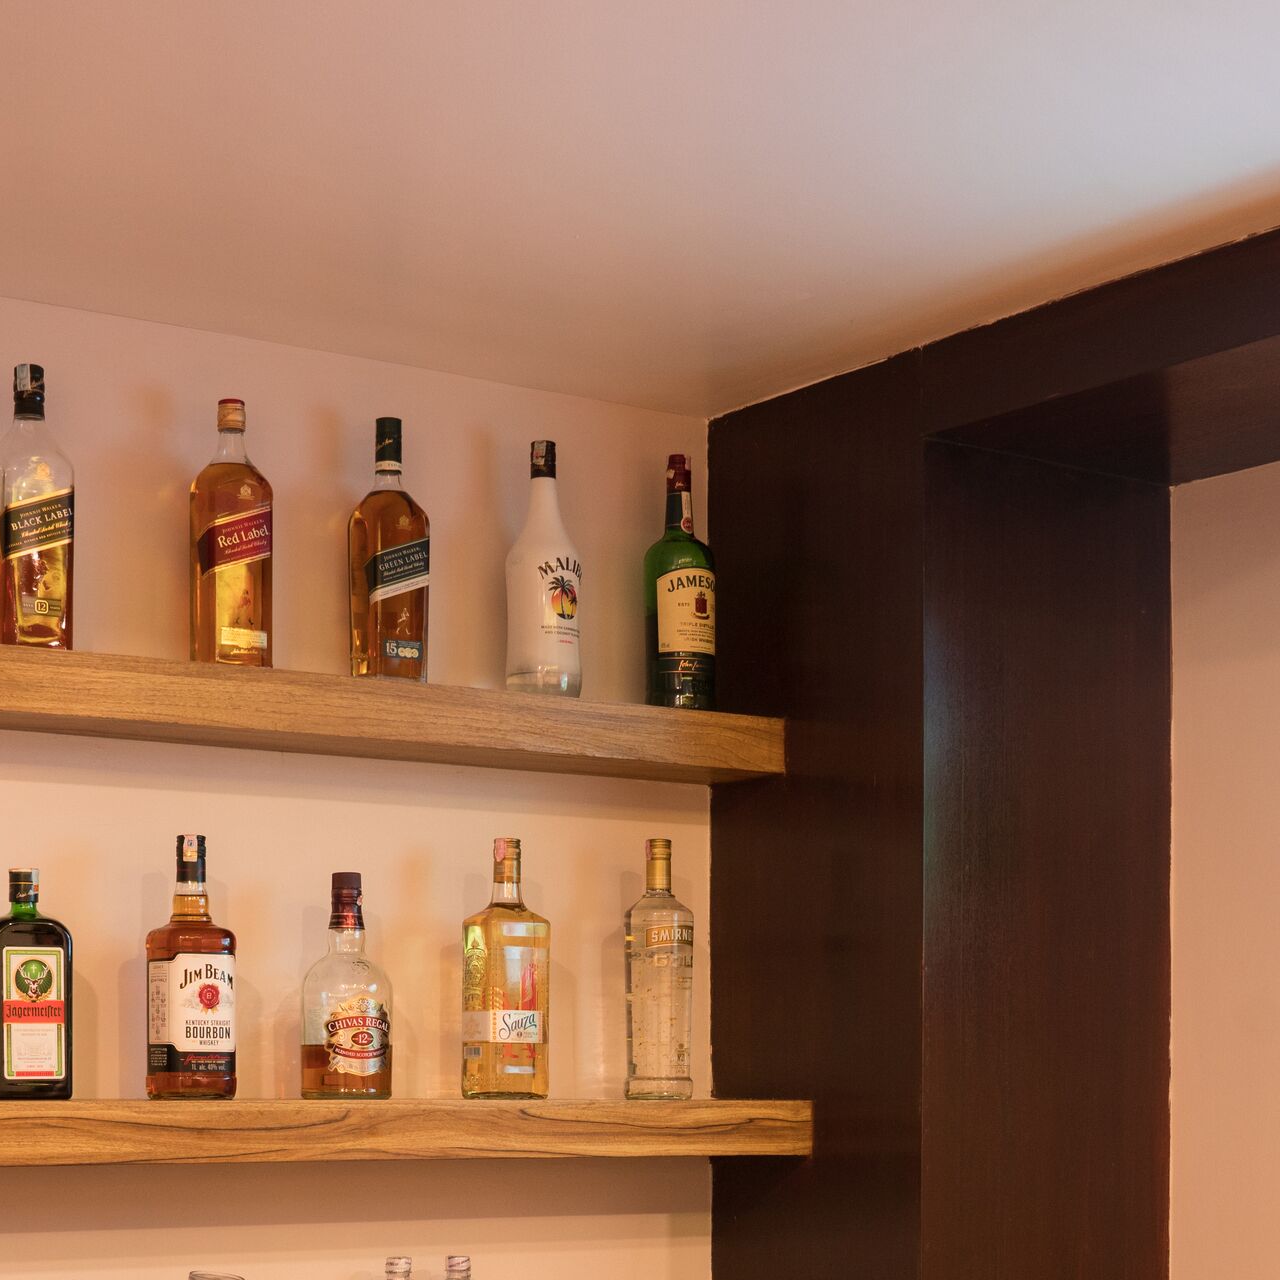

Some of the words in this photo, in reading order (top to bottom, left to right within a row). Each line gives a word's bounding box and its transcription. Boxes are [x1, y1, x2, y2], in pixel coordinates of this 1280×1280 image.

[11, 516, 42, 531] BLACK
[45, 508, 73, 521] LABEL
[217, 532, 240, 548] Red
[241, 524, 269, 541] Label
[379, 559, 404, 571] GREEN
[405, 551, 428, 563] LABEL
[37, 602, 46, 611] 12
[386, 642, 397, 654] 15
[179, 968, 202, 990] JIM
[205, 963, 233, 990] BEAM
[185, 1026, 231, 1039] BOURBON
[328, 1017, 364, 1032] CHIVAS
[365, 1017, 389, 1032] REGAL
[498, 1013, 537, 1040] Sauza
[358, 1033, 368, 1044] 12
